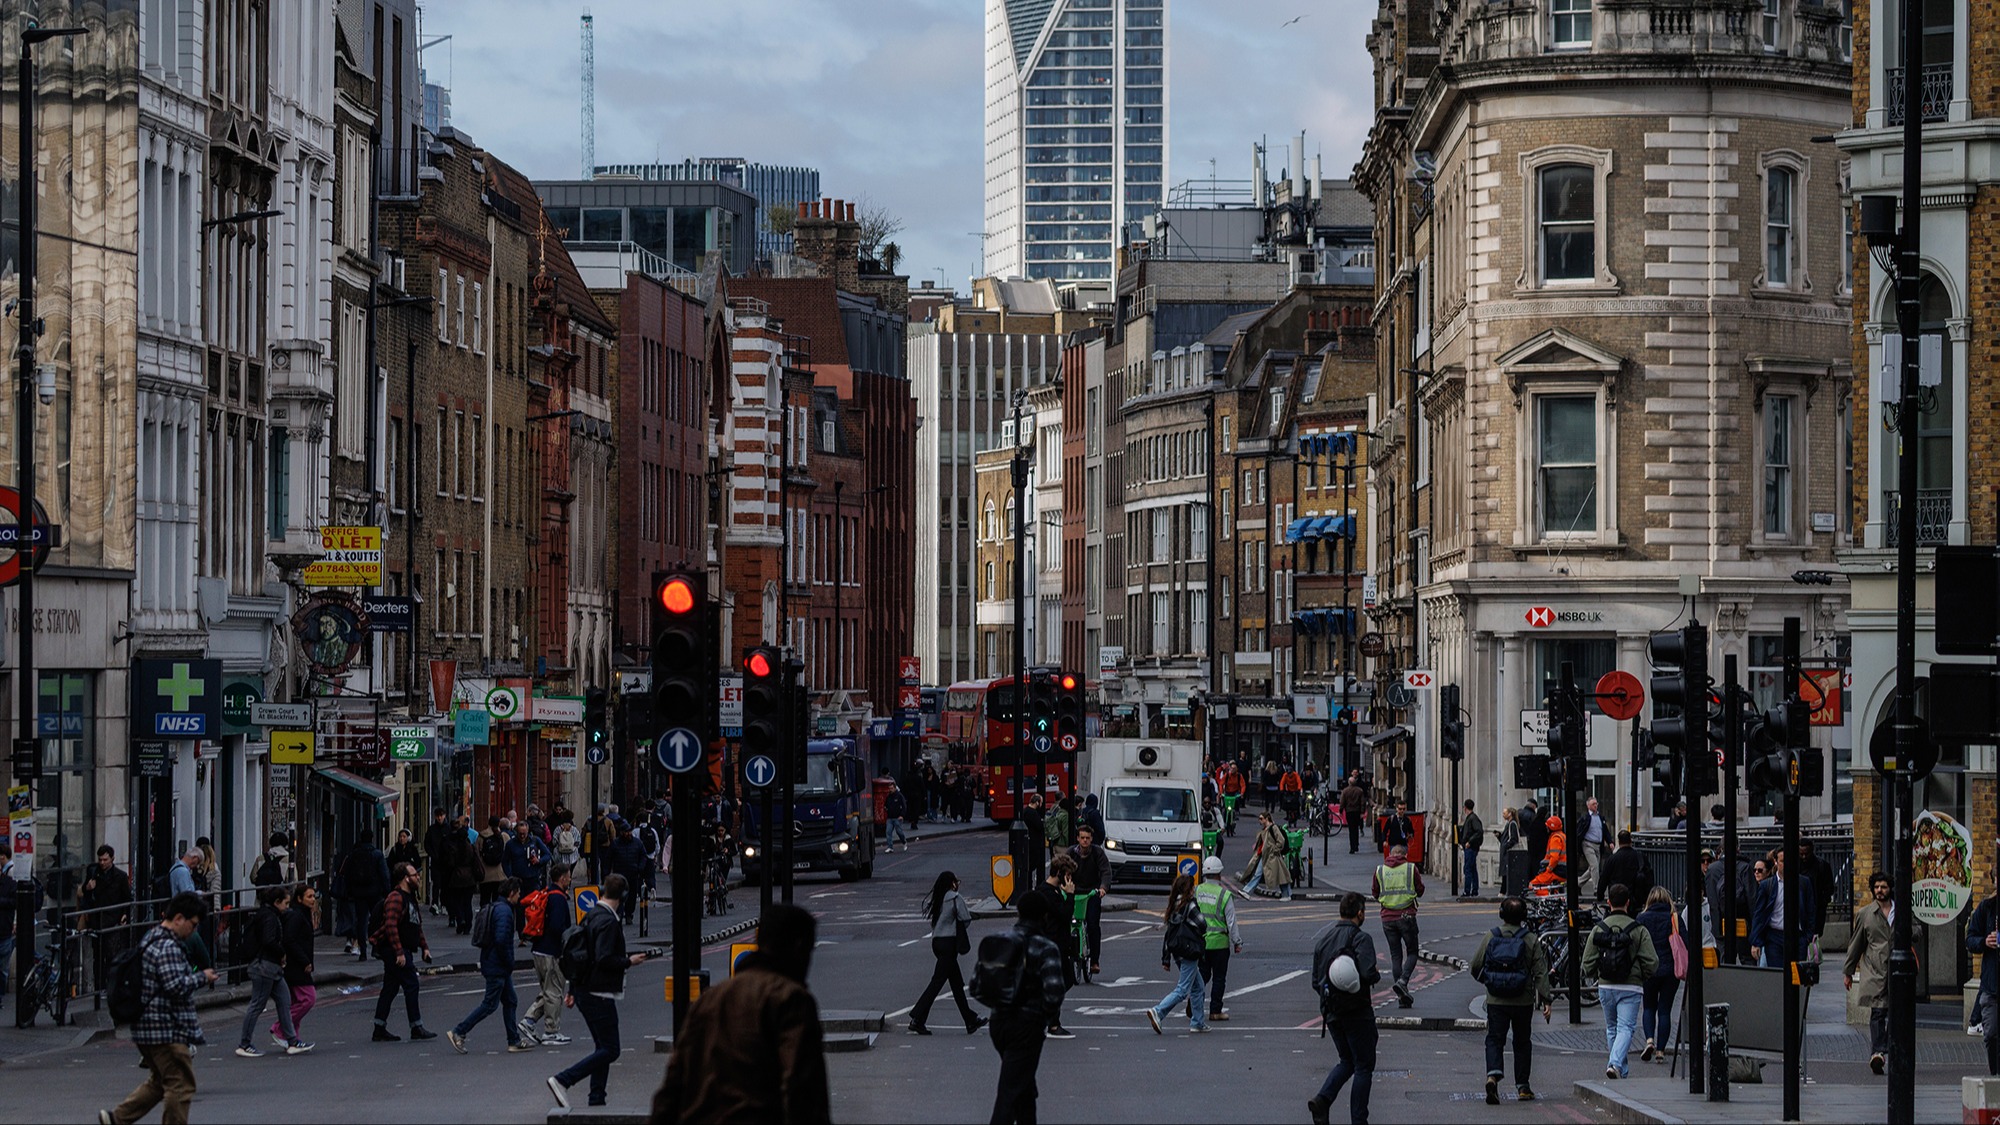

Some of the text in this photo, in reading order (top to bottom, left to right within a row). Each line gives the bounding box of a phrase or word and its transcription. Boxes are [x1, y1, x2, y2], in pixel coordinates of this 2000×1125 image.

[340, 536, 373, 548] LET
[335, 552, 342, 561] &
[345, 552, 379, 561] COUTTS
[364, 602, 409, 614] Dexters
[47, 609, 81, 633] STATION
[1558, 612, 1602, 621] HSBC UK
[463, 712, 484, 722] Café
[538, 708, 576, 716] Ryman
[1809, 708, 1834, 721] ON
[160, 717, 200, 731] NHS
[461, 723, 484, 733] Rossi
[391, 726, 429, 737] ondis
[397, 743, 419, 753] 24
